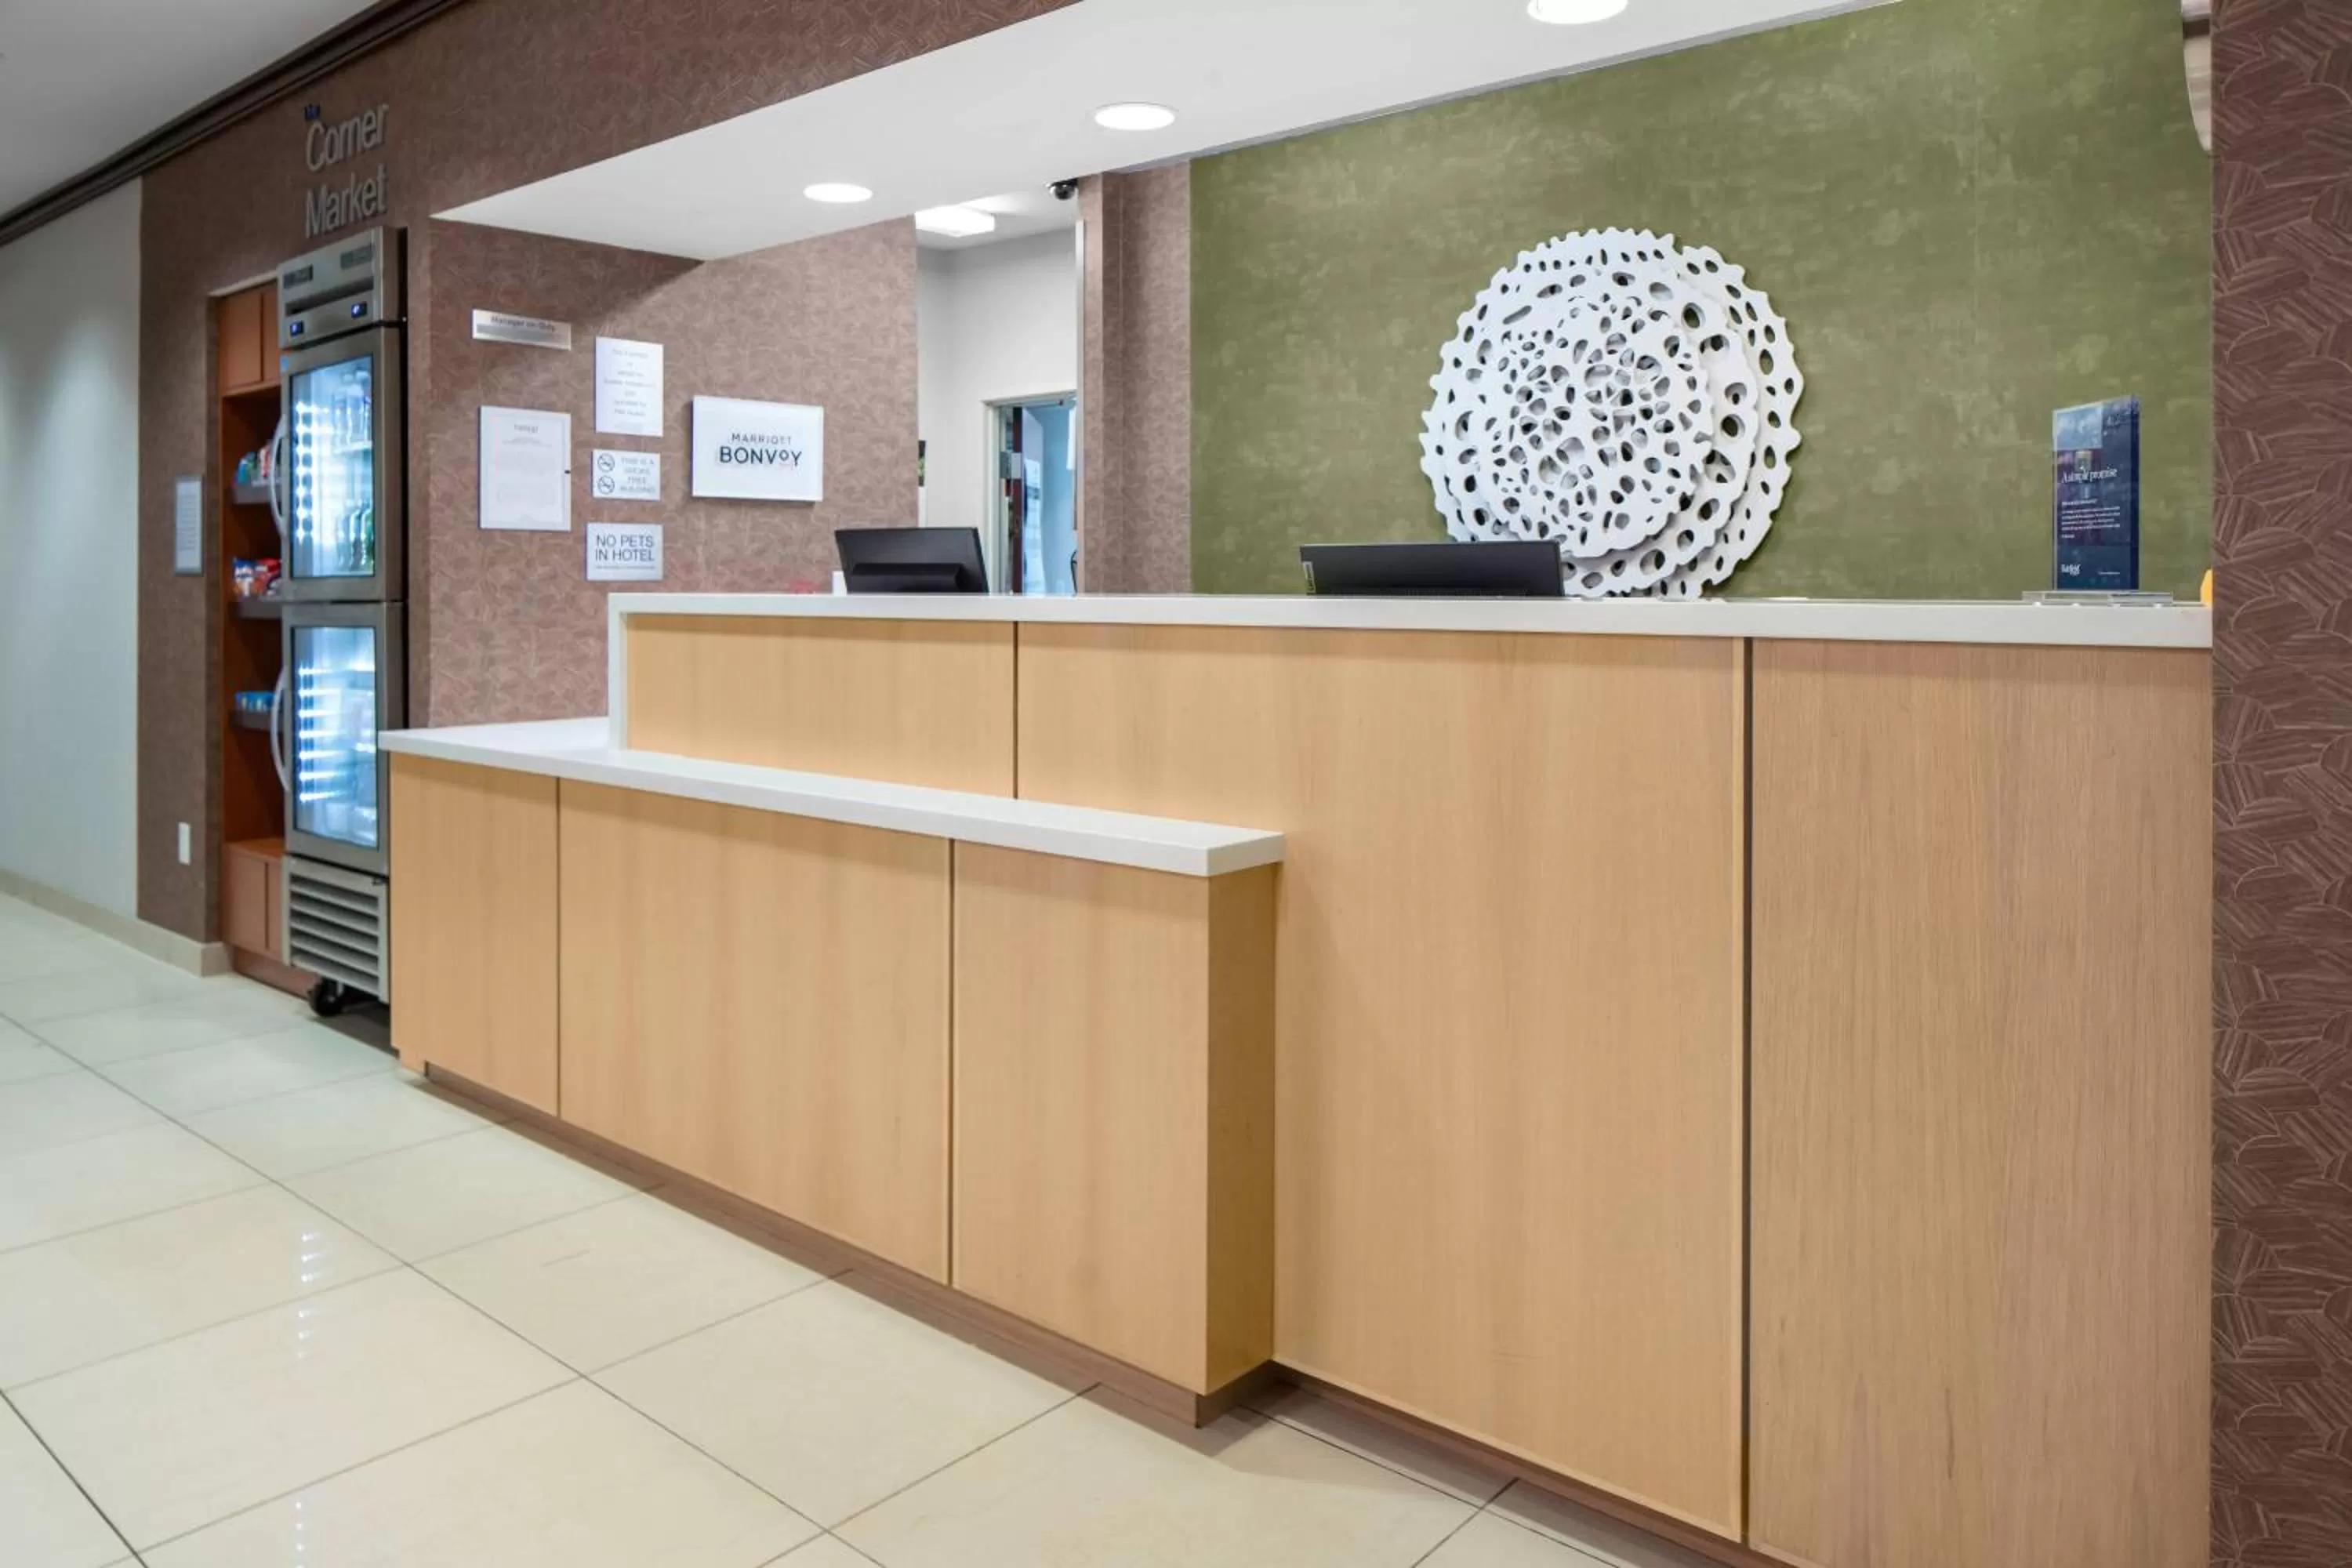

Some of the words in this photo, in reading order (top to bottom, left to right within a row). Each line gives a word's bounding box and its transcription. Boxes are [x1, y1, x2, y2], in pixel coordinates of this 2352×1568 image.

[306, 103, 389, 172] Corner
[305, 163, 388, 238] Market
[731, 433, 791, 445] MARRIOTT
[720, 446, 801, 466] BONVOY
[597, 534, 617, 548] NO
[620, 535, 654, 548] PETS
[595, 549, 608, 561] IN
[612, 549, 655, 562] HOTEL
